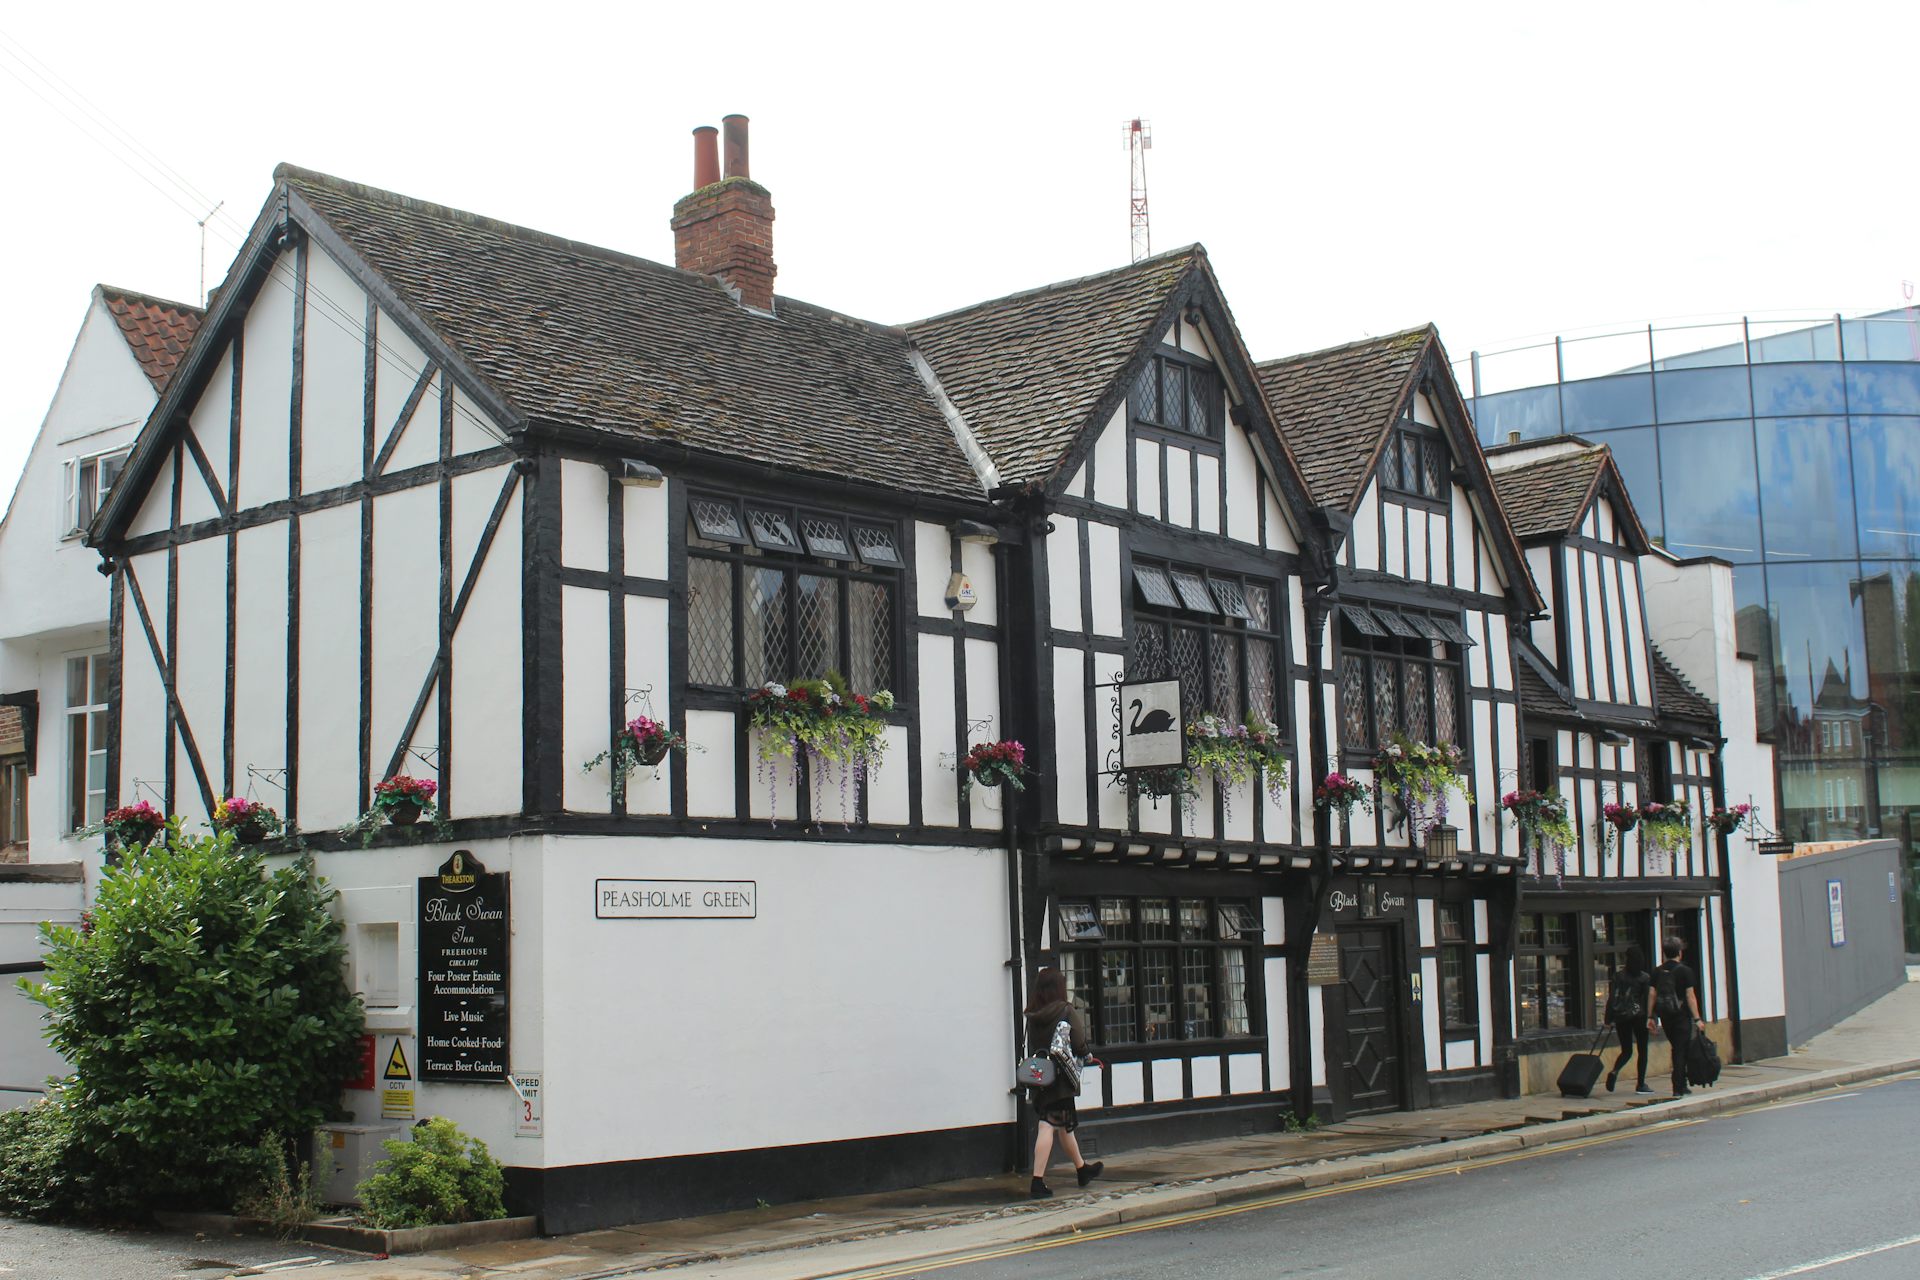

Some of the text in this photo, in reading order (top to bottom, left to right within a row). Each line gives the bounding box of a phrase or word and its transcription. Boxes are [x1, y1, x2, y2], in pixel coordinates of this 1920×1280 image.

[441, 874, 475, 884] THEAKSTON
[602, 891, 751, 908] PEASHOLME GREEN
[1329, 890, 1405, 912] Black Swan
[424, 896, 503, 922] Black Swan
[451, 925, 475, 944] Inn
[441, 947, 488, 957] FREEHOUSE
[448, 959, 466, 967] CIRCA
[427, 970, 502, 982] Four Poster Ensuite
[433, 983, 495, 995] Accommodation
[443, 1010, 485, 1022] Live Music
[427, 1035, 502, 1049] Home Cooked Food
[425, 1059, 503, 1073] Terrace Beer Garden
[389, 1081, 406, 1090] CCTV
[516, 1078, 540, 1087] SPEED
[522, 1089, 538, 1098] IMIT
[524, 1100, 532, 1122] 3
